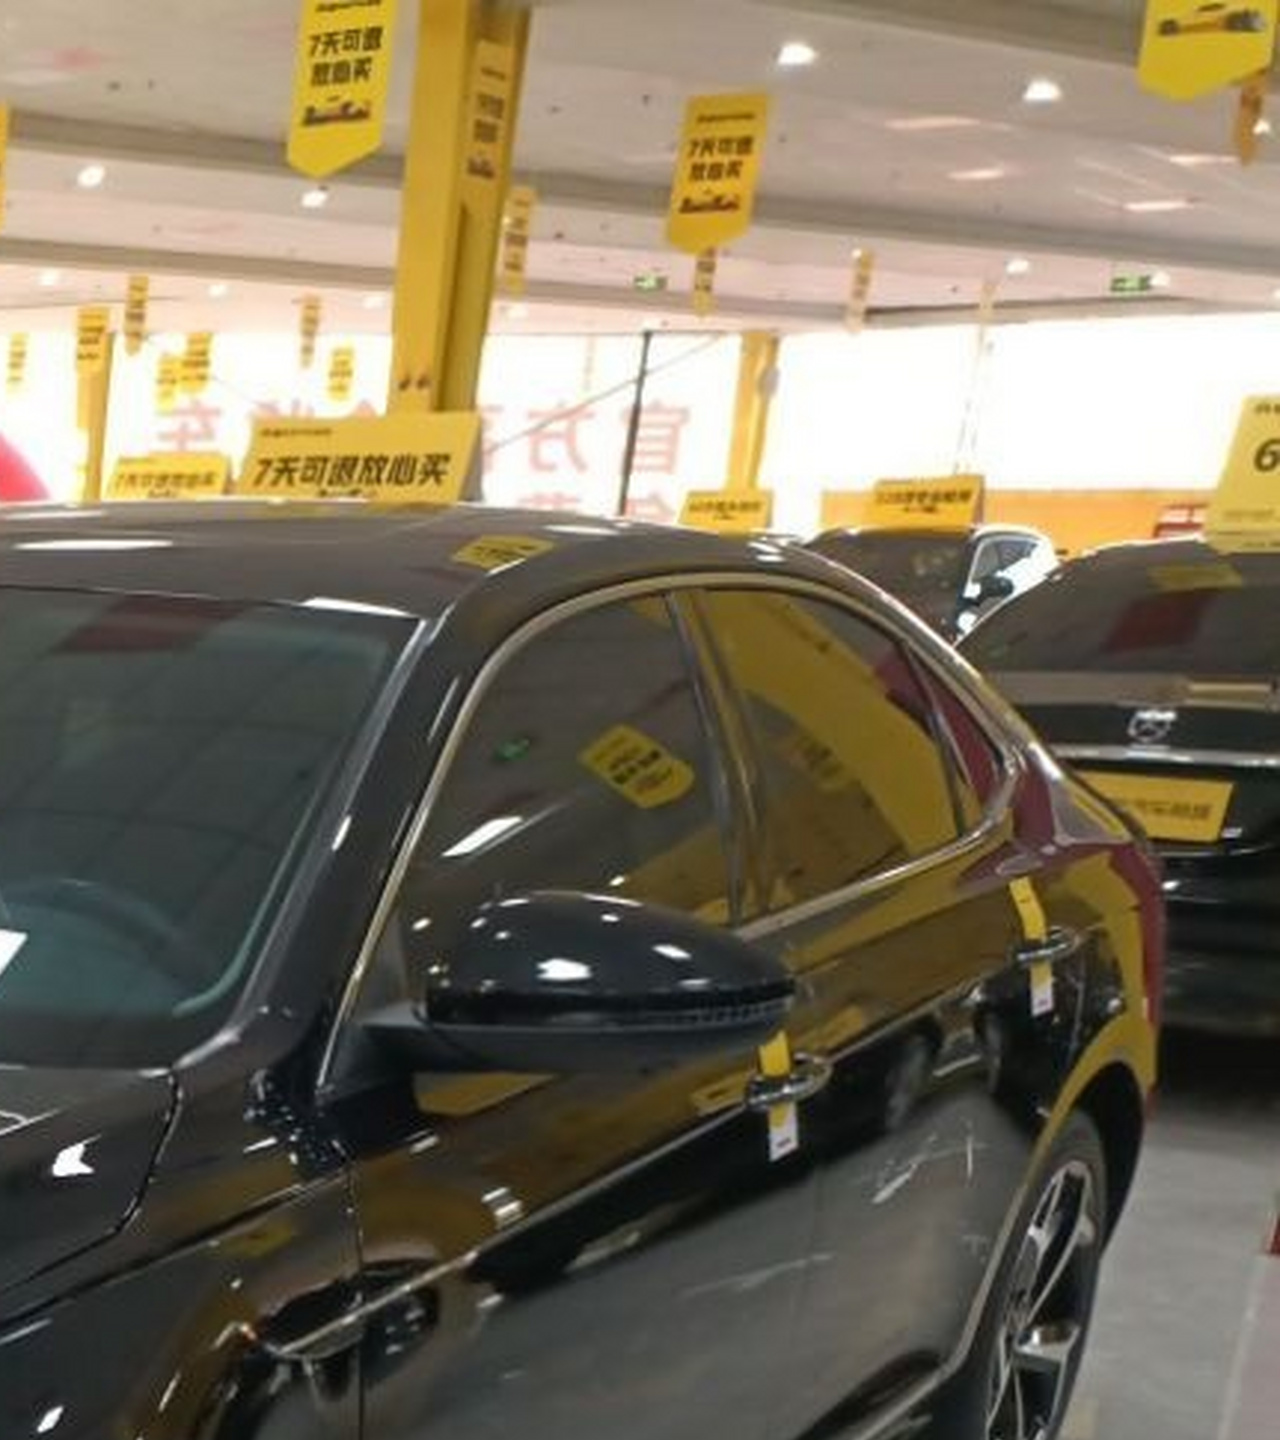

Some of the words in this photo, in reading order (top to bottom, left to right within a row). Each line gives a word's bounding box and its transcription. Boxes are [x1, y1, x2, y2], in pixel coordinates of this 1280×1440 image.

[252, 453, 453, 489] 7天可退放心买
